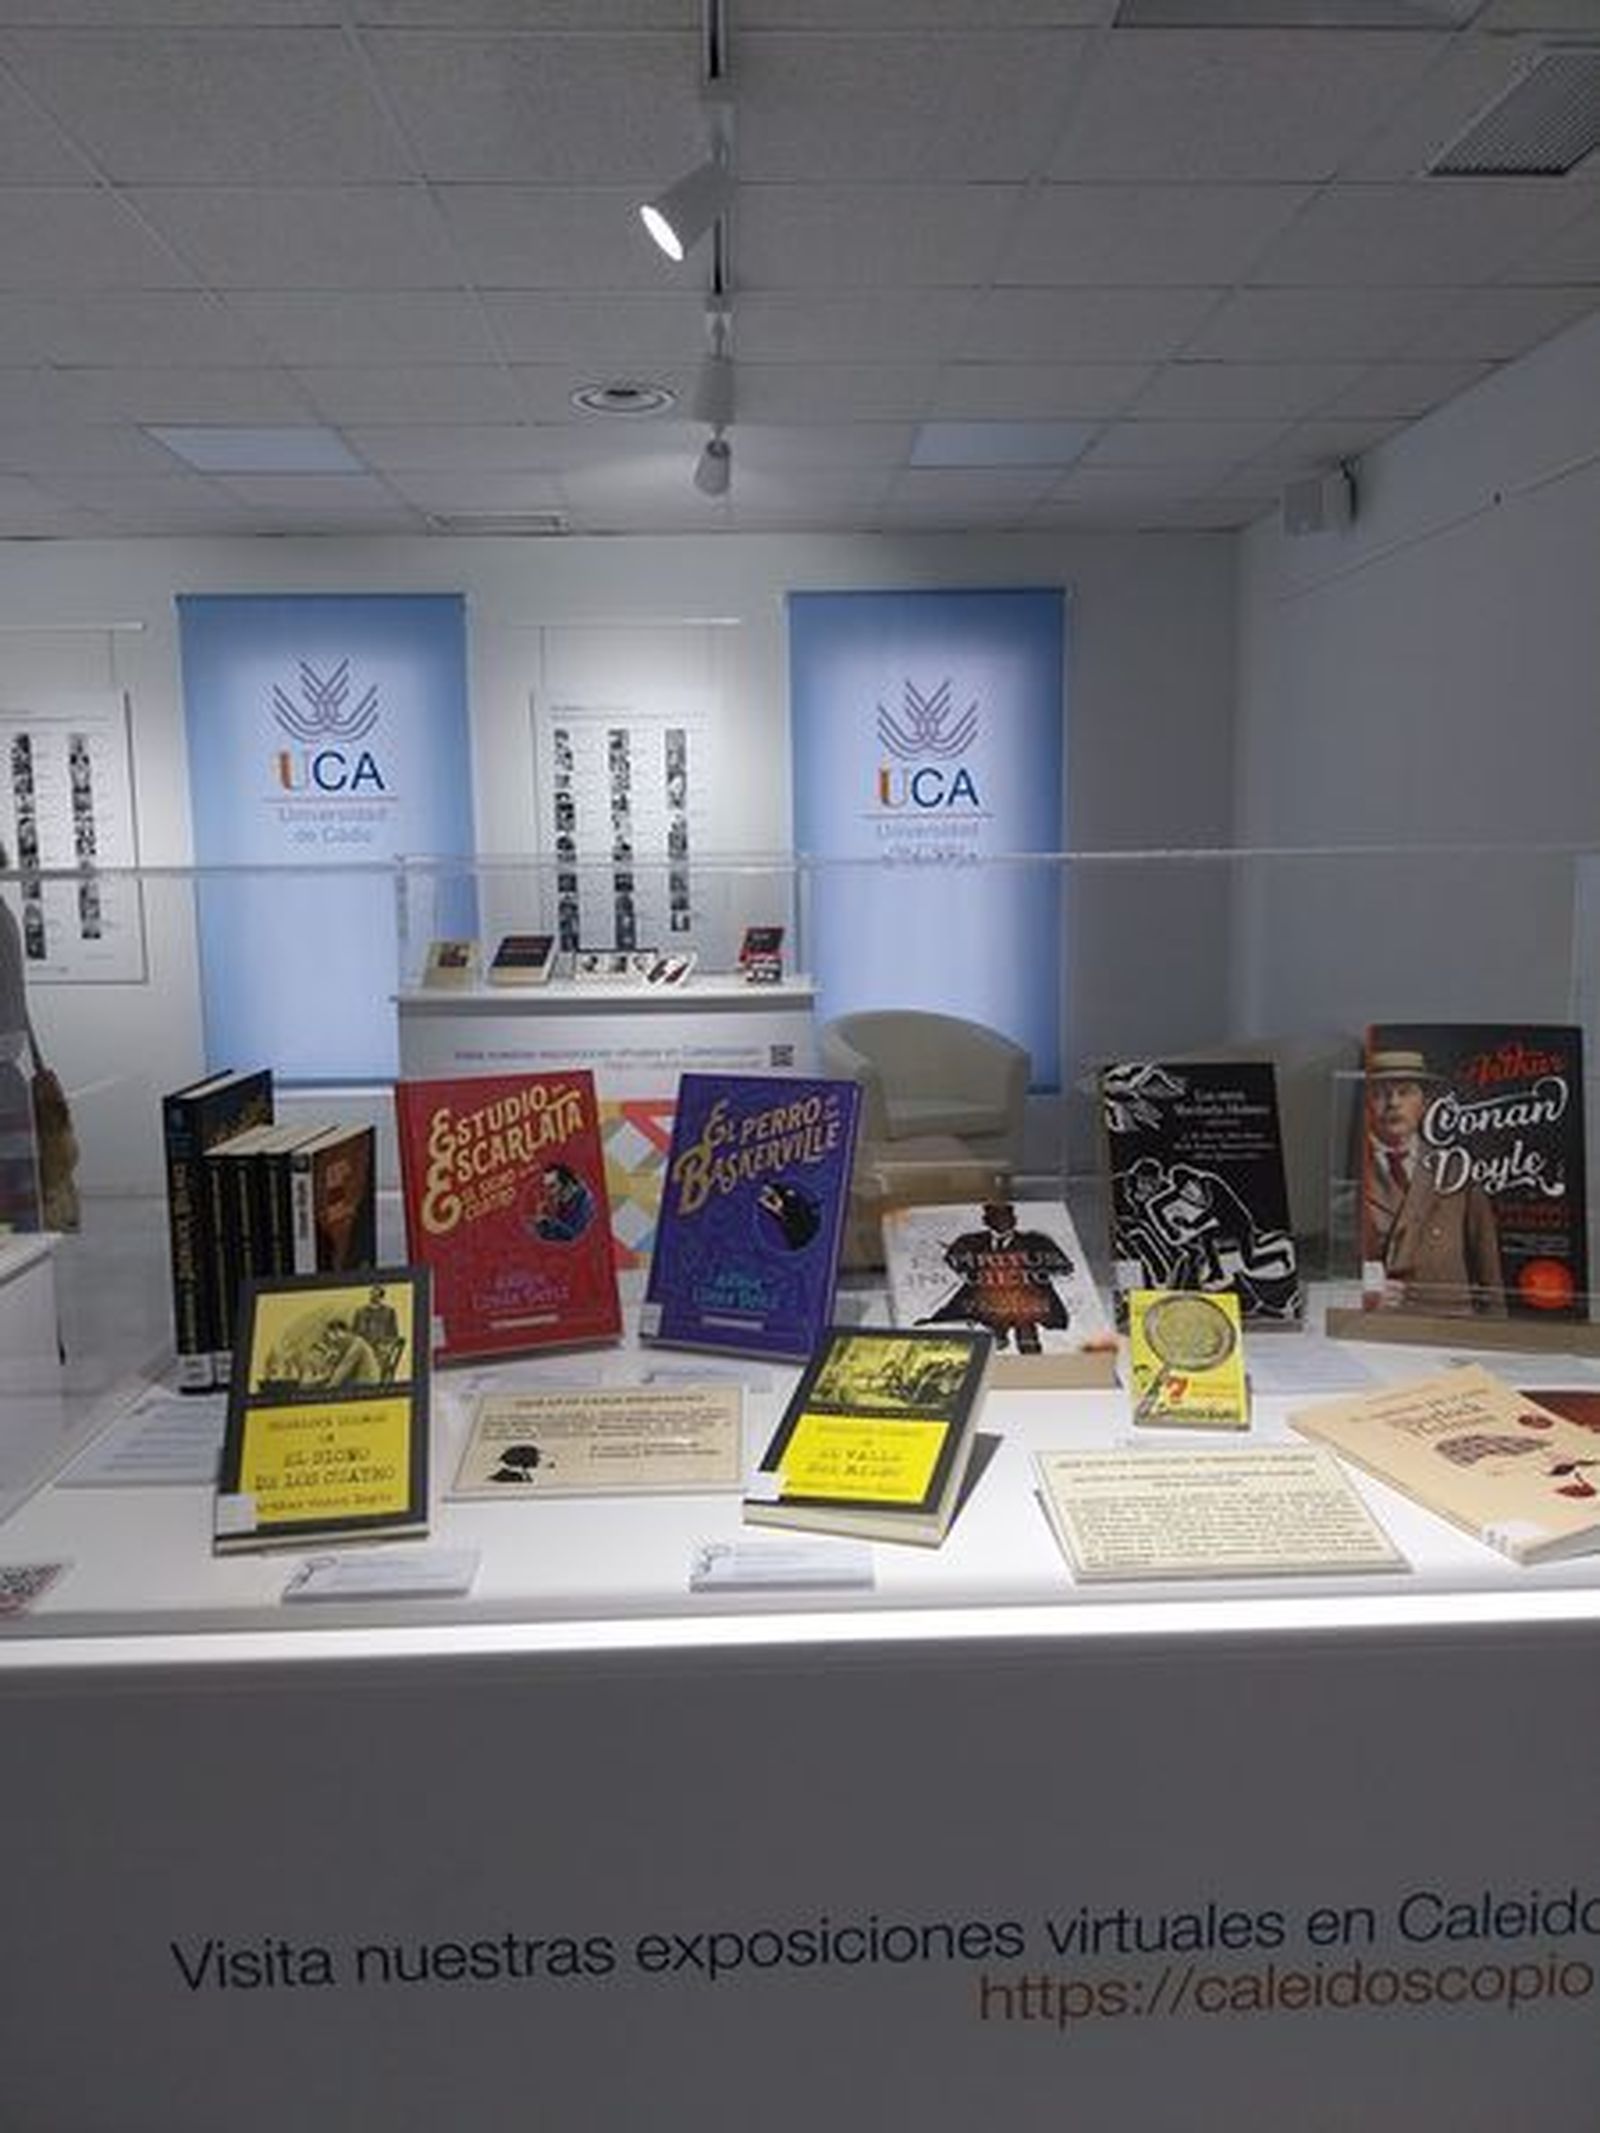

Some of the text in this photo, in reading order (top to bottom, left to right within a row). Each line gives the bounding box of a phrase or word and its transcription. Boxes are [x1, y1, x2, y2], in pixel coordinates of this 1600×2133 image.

[272, 750, 386, 791] UCA
[878, 764, 980, 808] UCA
[738, 1095, 822, 1146] PERRO
[1423, 1075, 1569, 1146] Conan
[421, 1090, 584, 1235] ESCARLATA
[672, 1120, 841, 1218] BASKERVILLE
[1423, 1140, 1566, 1197] Doyle
[170, 1937, 336, 1992] Visita
[356, 1932, 617, 1984] nuestras
[635, 1916, 1025, 1981] exposiciones
[1046, 1904, 1285, 1955] virtuales
[1306, 1903, 1376, 1945] en
[979, 1953, 1594, 2031] https://caleidoscopio
